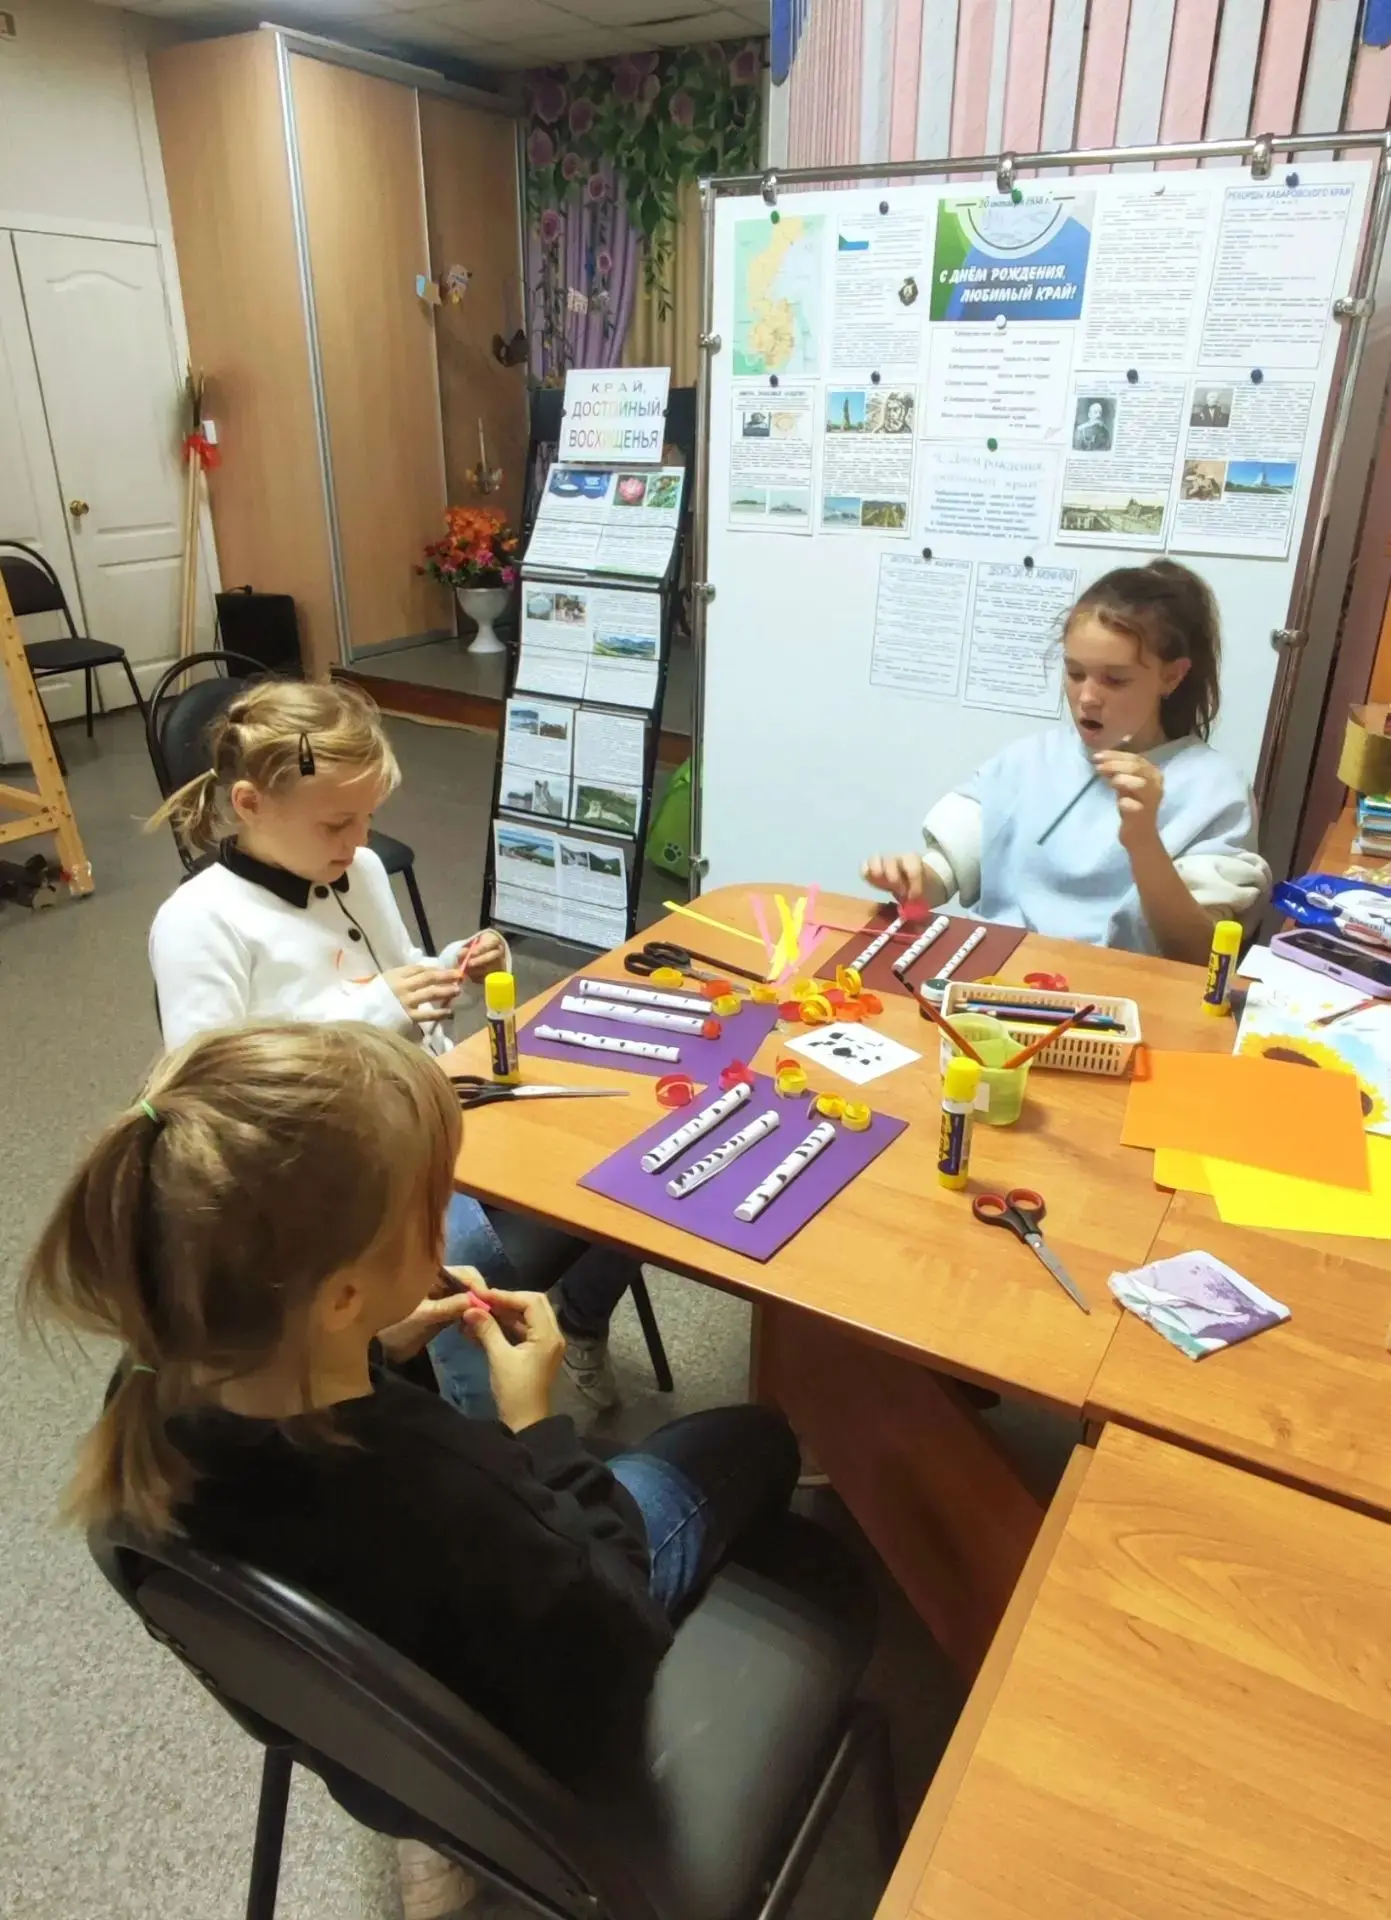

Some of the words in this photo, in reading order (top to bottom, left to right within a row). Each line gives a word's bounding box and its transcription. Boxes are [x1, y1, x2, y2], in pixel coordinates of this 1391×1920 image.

[939, 270, 948, 283] С
[949, 264, 987, 284] ДНЁМ
[990, 264, 1066, 283] РОЖДЕНИЯ,
[960, 283, 1034, 303] ЛЮБИМЫЙ
[1035, 282, 1077, 302] КРАЙ!
[568, 429, 659, 453] ВОСХЩЕНЬЯ
